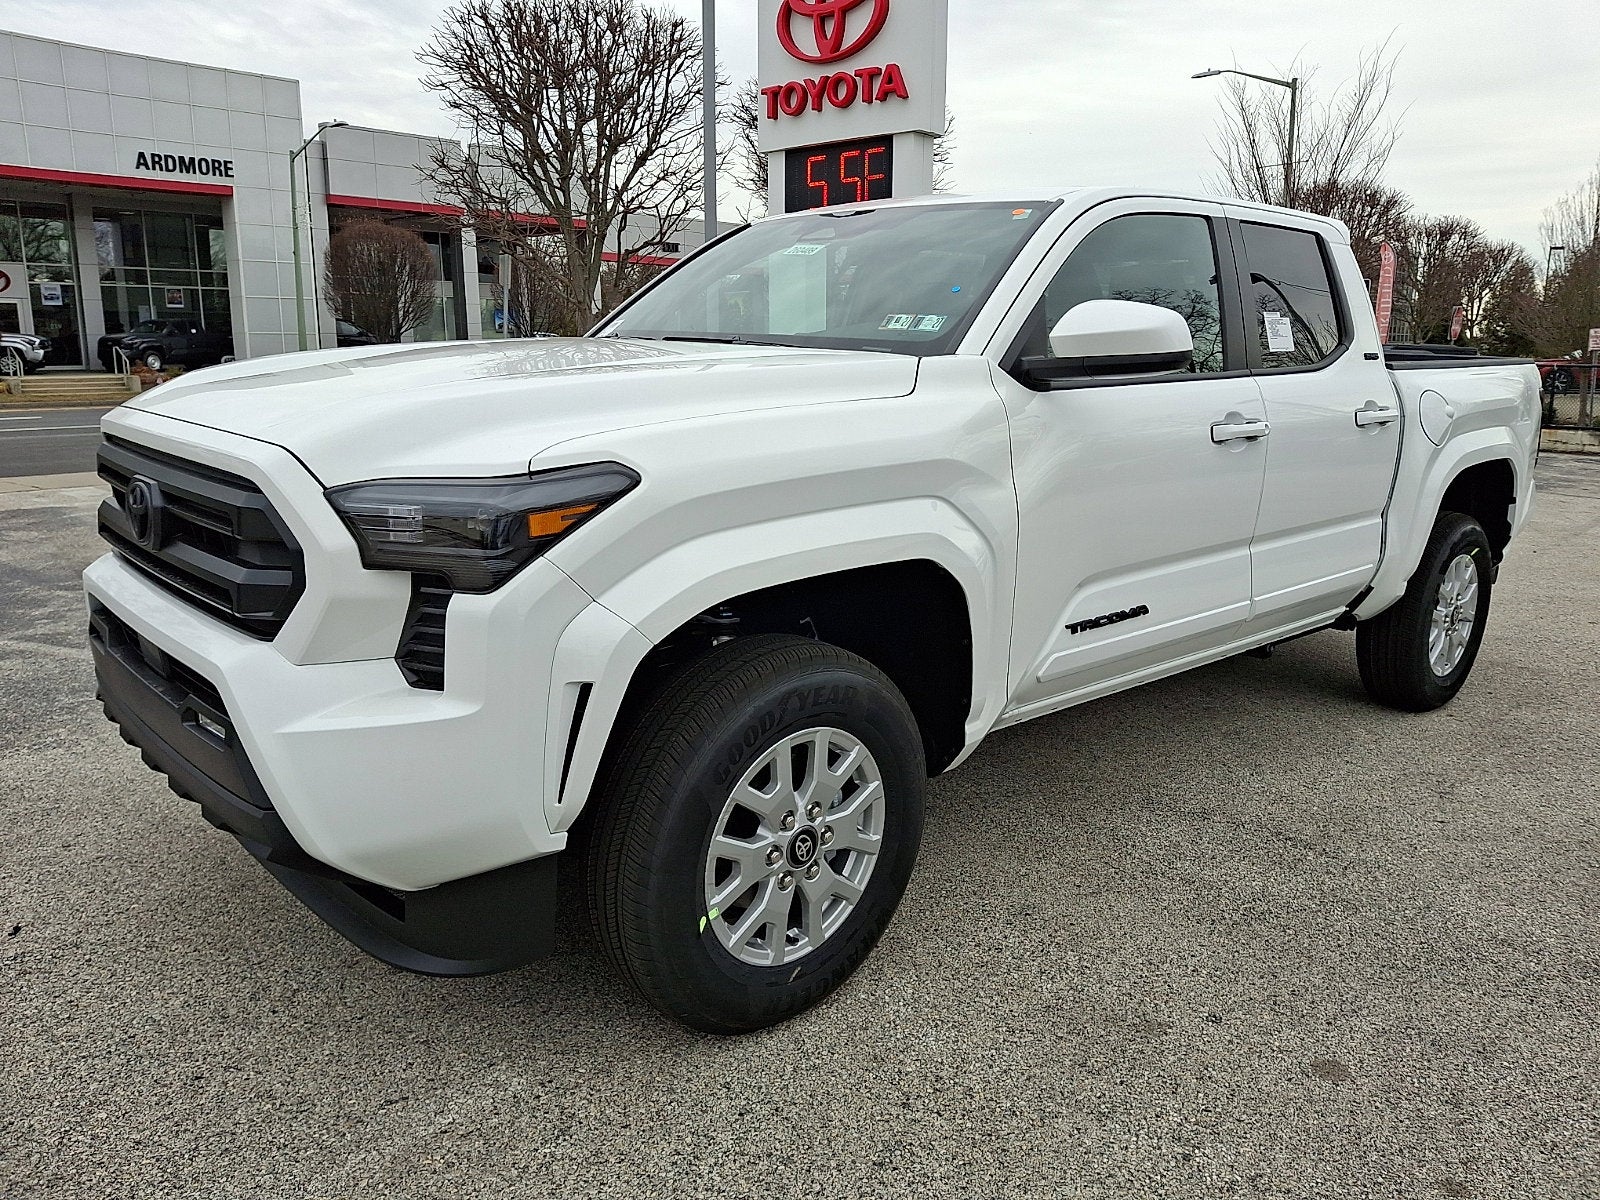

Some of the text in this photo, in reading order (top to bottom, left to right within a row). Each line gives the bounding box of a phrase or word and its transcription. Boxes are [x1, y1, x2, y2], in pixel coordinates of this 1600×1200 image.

[761, 63, 909, 120] TOYOTA
[135, 151, 235, 178] ARDMORE
[1065, 604, 1150, 635] TACOMA
[712, 684, 860, 785] GOODYEAR
